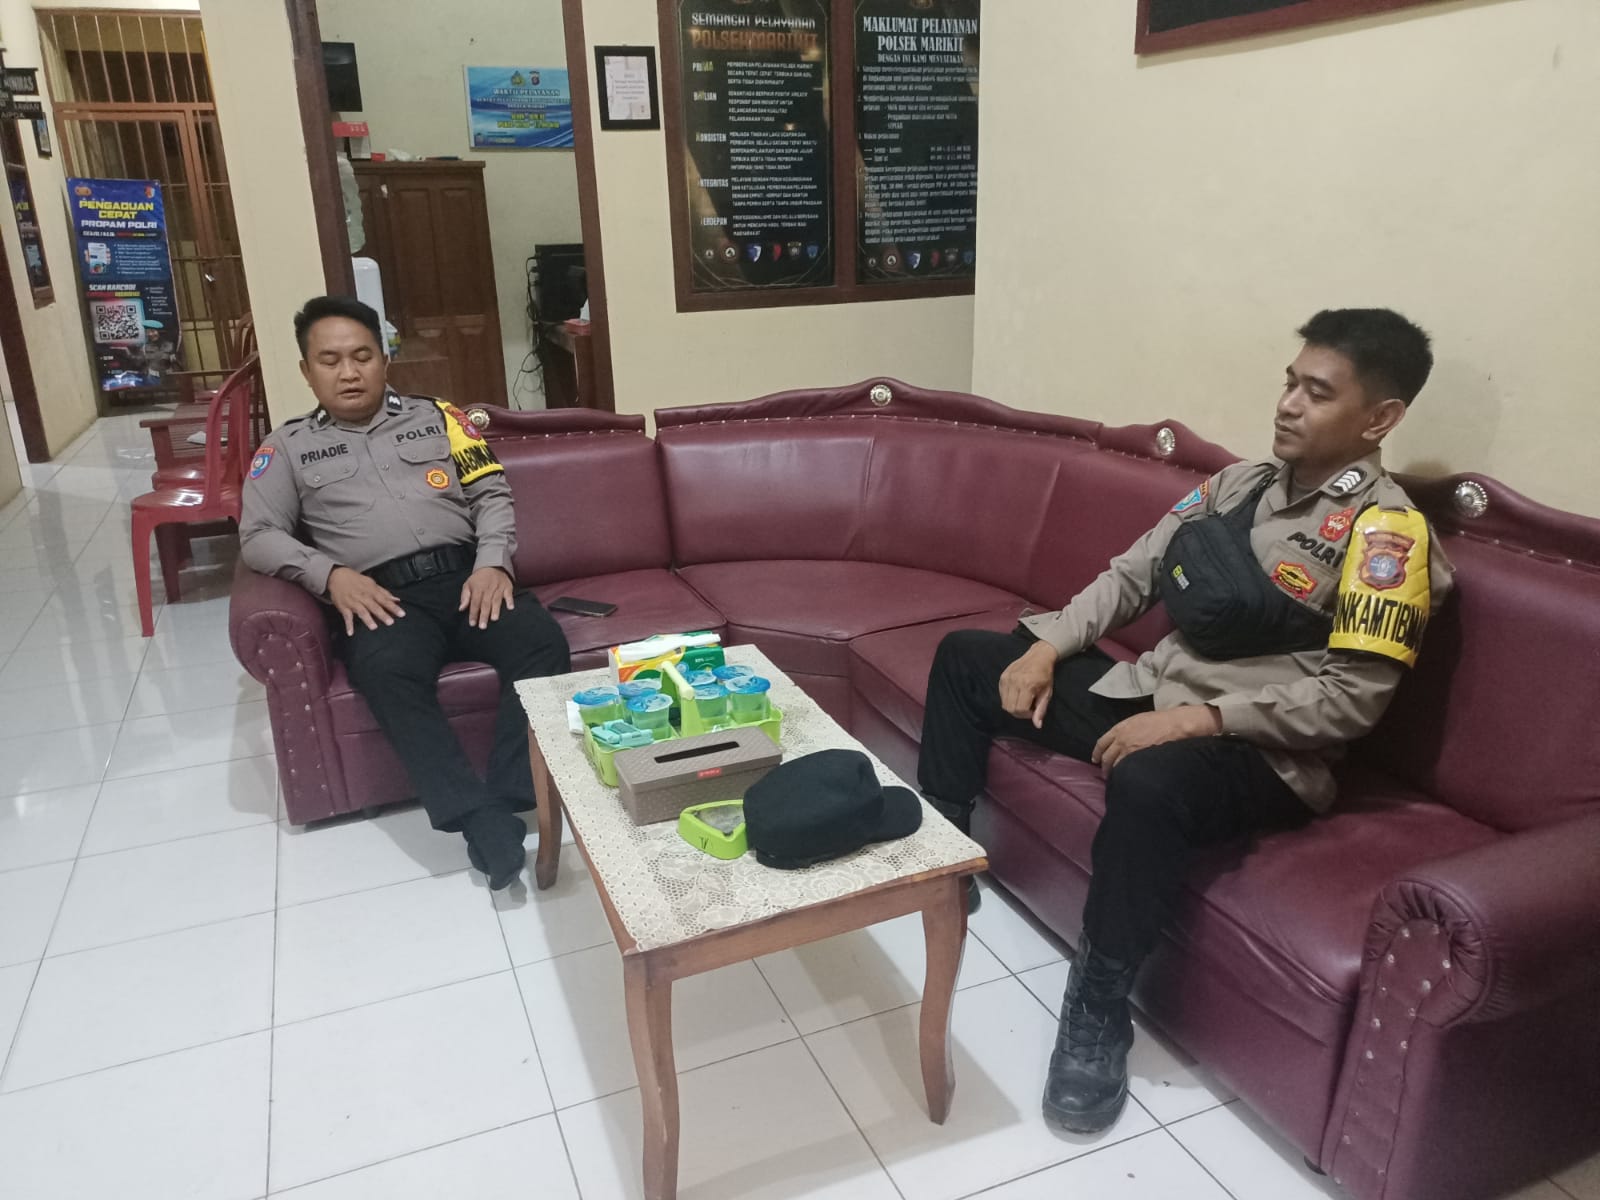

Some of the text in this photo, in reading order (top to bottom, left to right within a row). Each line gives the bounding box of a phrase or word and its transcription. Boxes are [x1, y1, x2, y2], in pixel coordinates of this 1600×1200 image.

[691, 11, 817, 29] SEMANGAT PELAYANAN
[863, 16, 978, 35] MAKLUMAT PELAYANAN
[878, 35, 964, 52] POLSEK MARIKIT
[79, 200, 154, 211] PENGADUAN
[98, 210, 138, 220] CEPAT
[81, 219, 158, 230] PROPAM POLRI
[395, 424, 442, 443] POLRI
[300, 443, 349, 465] PRIADIE
[1287, 531, 1344, 568] POLRI
